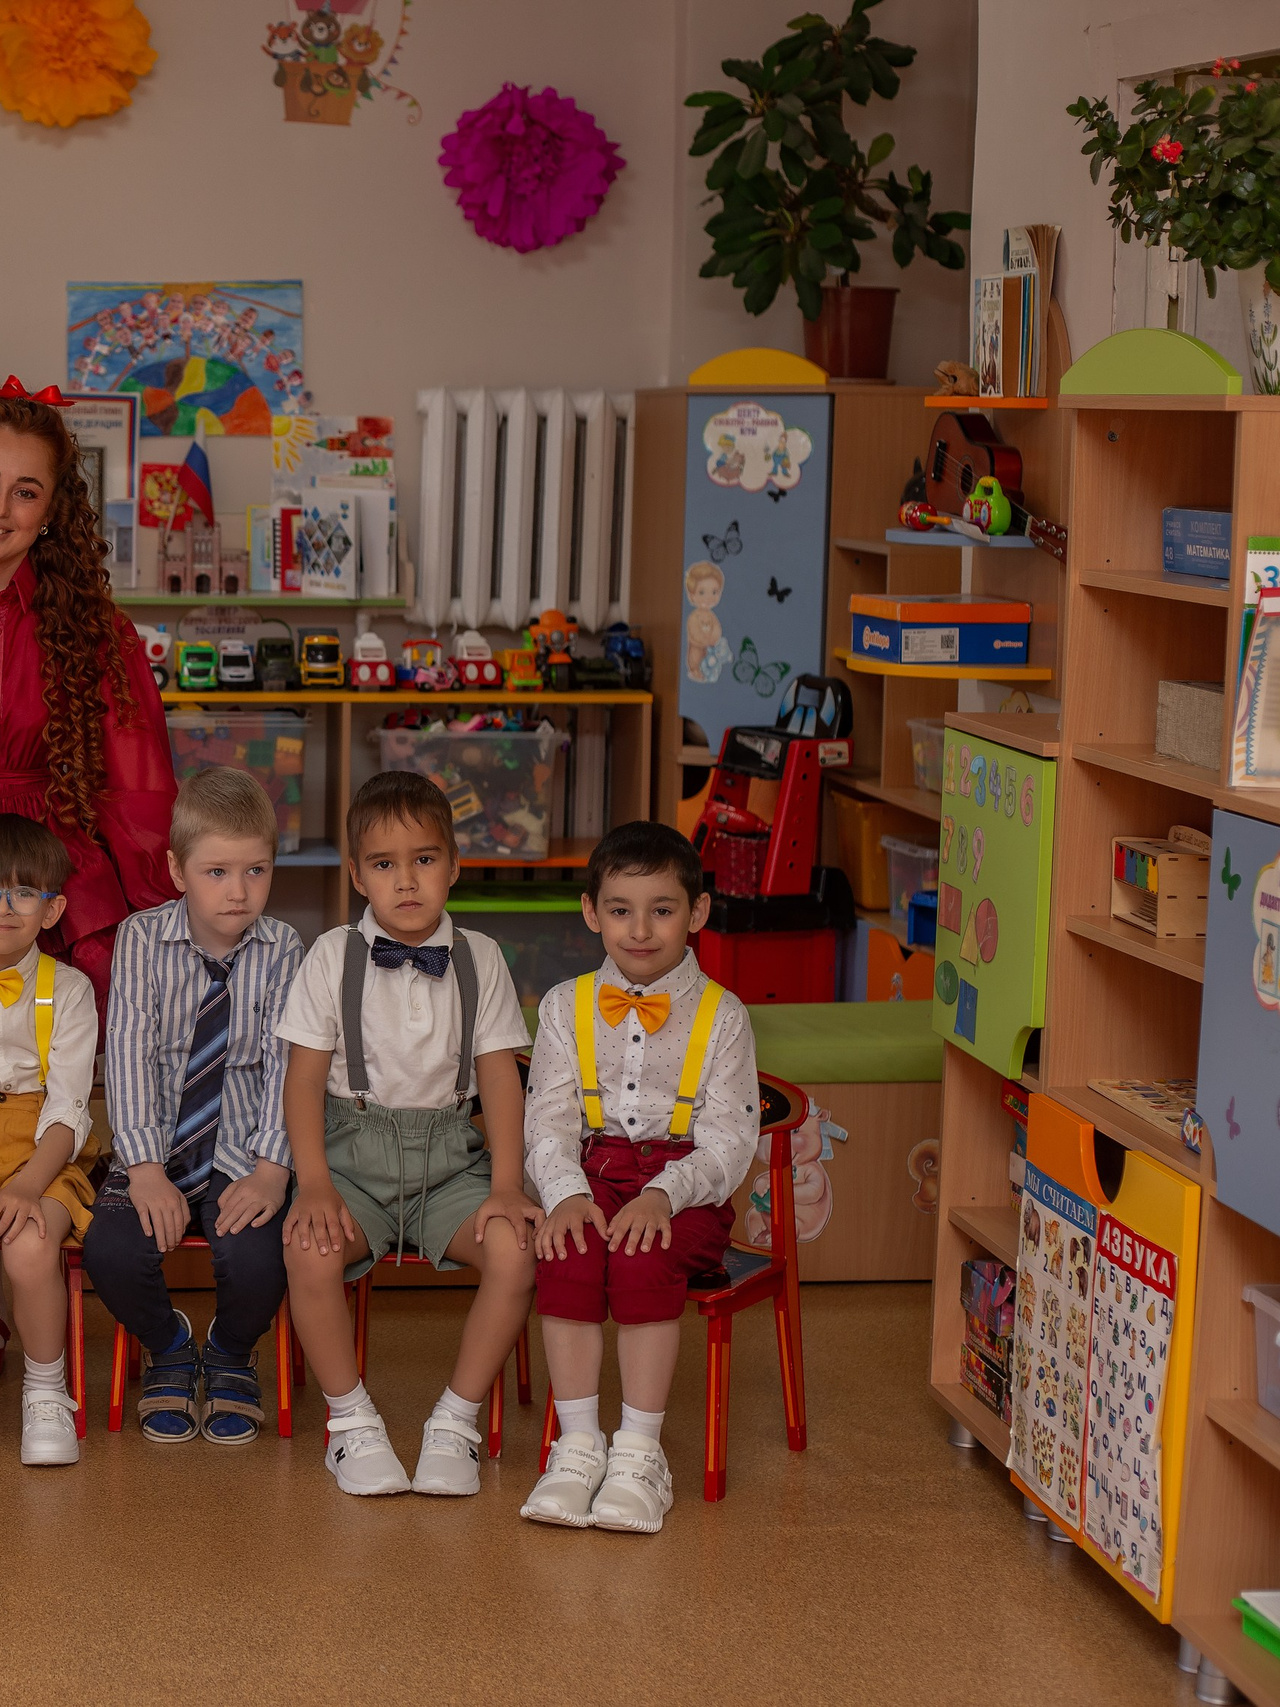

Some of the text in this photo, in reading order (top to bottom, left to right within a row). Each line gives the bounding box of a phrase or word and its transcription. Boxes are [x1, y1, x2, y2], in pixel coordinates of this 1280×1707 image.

[1190, 521, 1222, 534] КОМПЛЕКТ
[1186, 544, 1230, 561] МАТЕМАТИКА
[960, 744, 971, 798] 2
[970, 754, 987, 808] 3
[988, 758, 1002, 812] 4
[1004, 764, 1017, 818] 5
[1020, 774, 1035, 827] 6
[941, 814, 955, 864] 7
[972, 826, 985, 884] 9
[1026, 1168, 1040, 1195] МЫ
[1042, 1180, 1095, 1232] СЧИТАЕМ
[1043, 1253, 1048, 1273] 2
[1068, 1271, 1073, 1290] 3
[1101, 1221, 1171, 1289] АЗБУКА
[1096, 1255, 1102, 1273] А
[1109, 1265, 1116, 1283] Б
[1125, 1276, 1132, 1294] В
[1141, 1286, 1148, 1303] Г
[1094, 1299, 1099, 1316] Е
[1108, 1307, 1114, 1325] Ё
[1123, 1318, 1131, 1340] Ж
[1040, 1319, 1045, 1340] 5
[1065, 1341, 1070, 1360] 6
[1106, 1350, 1112, 1368] К
[1120, 1361, 1127, 1379] Л
[1138, 1372, 1147, 1392] М
[1034, 1390, 1040, 1408] 8
[1062, 1409, 1067, 1427] 9
[1119, 1403, 1125, 1420] Р
[1135, 1416, 1142, 1434] С
[559, 1467, 587, 1480] SPORT
[567, 1448, 601, 1465] FASHION
[1102, 1433, 1109, 1451] Ф
[1133, 1457, 1141, 1478] Ц
[1058, 1477, 1065, 1499] 12
[1132, 1502, 1141, 1523] Ы
[1131, 1542, 1138, 1559] Я
